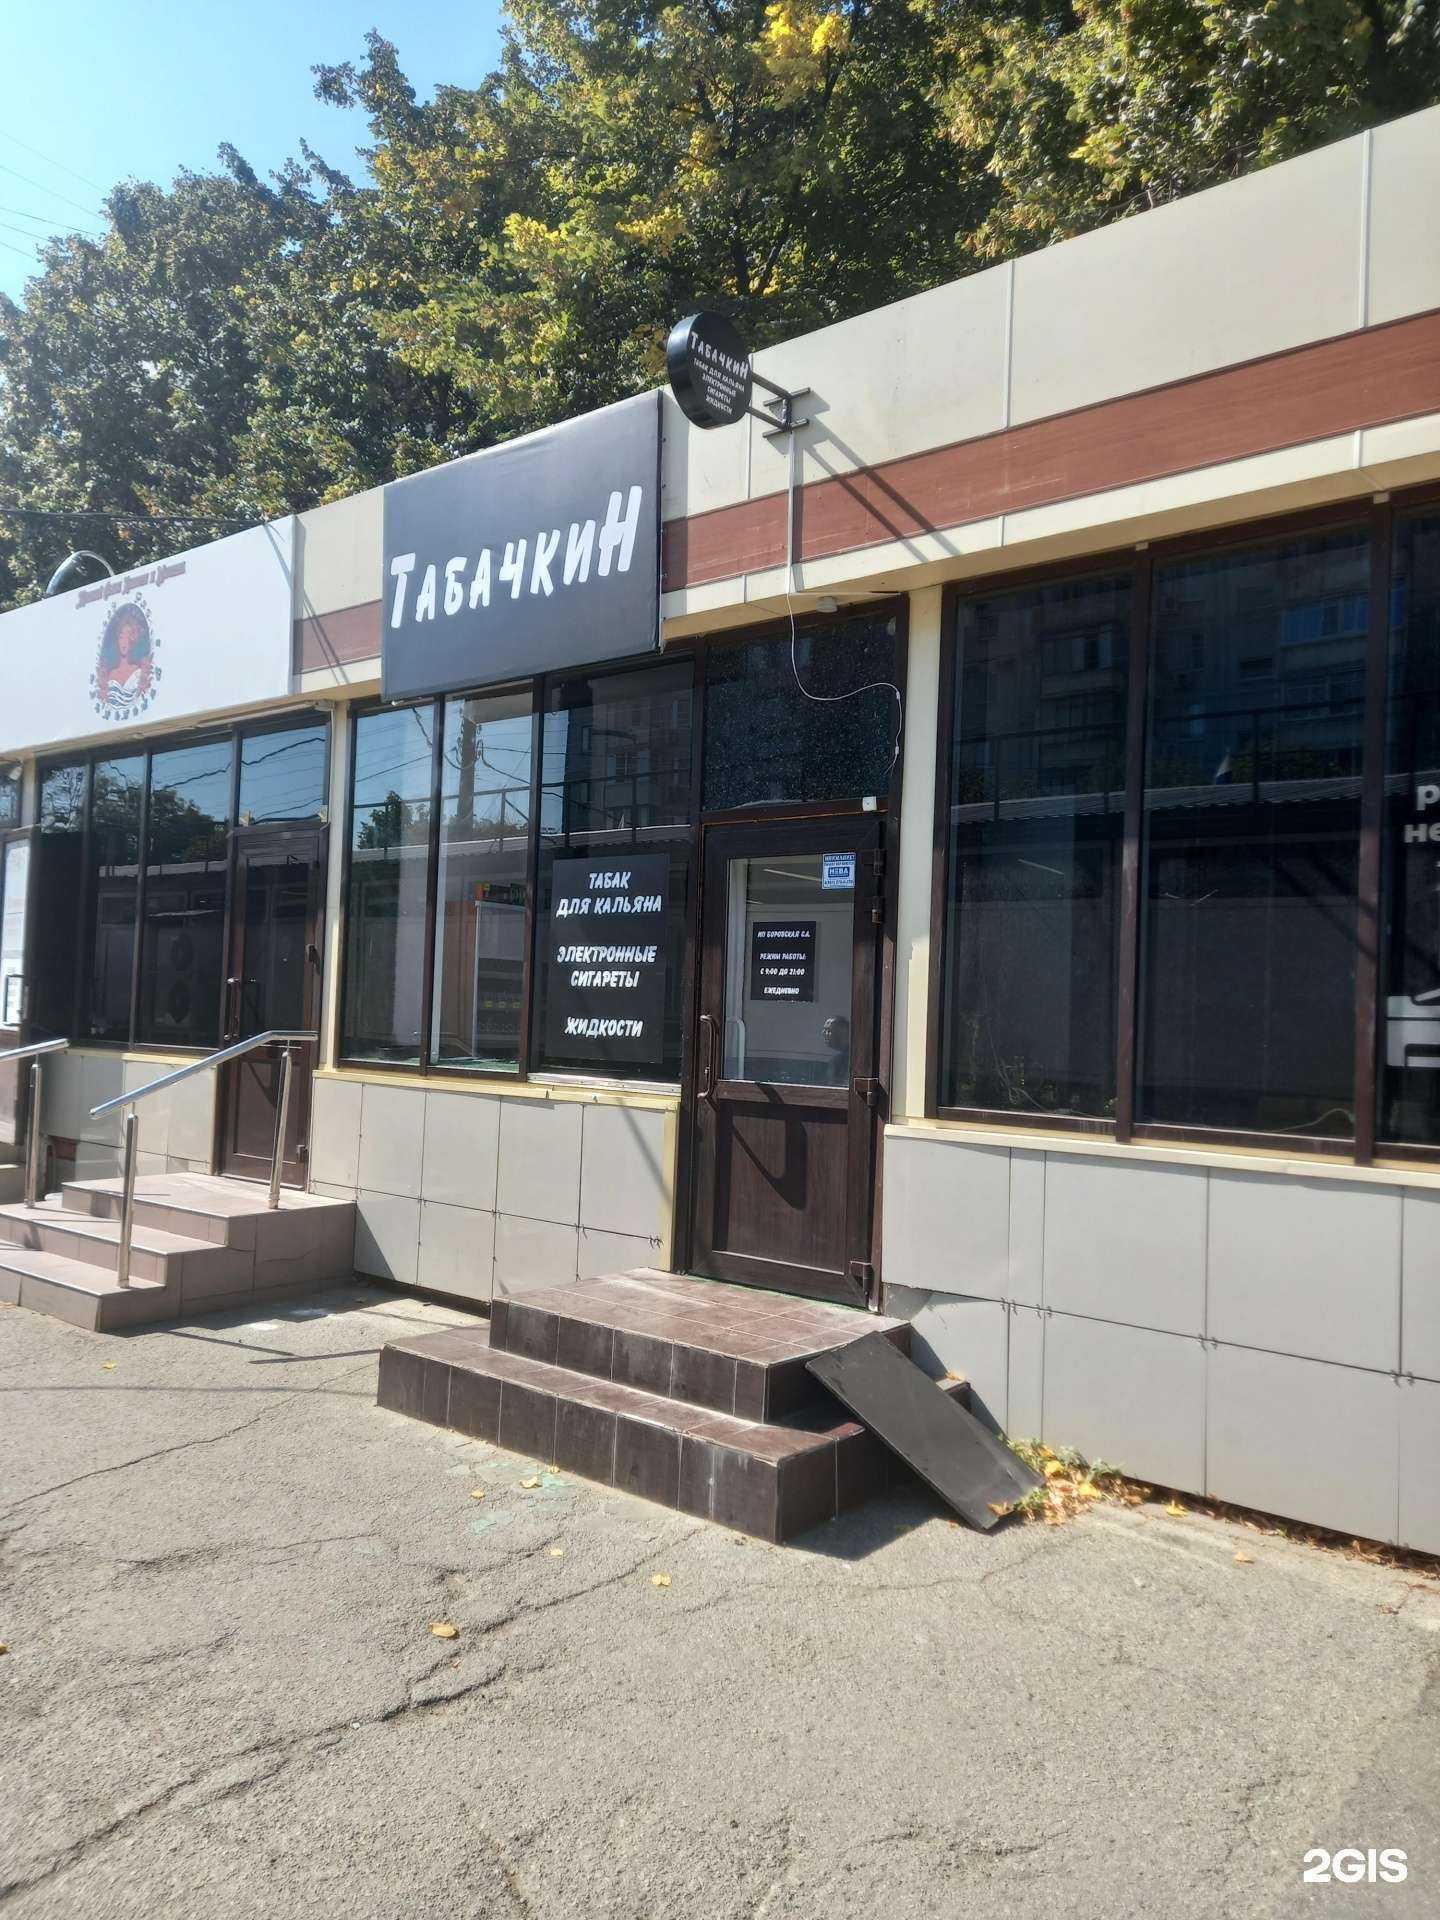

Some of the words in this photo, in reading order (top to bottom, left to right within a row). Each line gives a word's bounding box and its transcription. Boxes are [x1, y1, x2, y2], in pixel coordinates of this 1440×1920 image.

[691, 331, 749, 379] ТАБАЧКИН
[709, 367, 722, 379] ДЛЯ
[390, 485, 643, 629] ТАБАЧКИН
[589, 871, 632, 889] ТАБАК
[556, 897, 591, 918] ДЛЯ
[594, 895, 662, 915] КАЛЬЯНА
[557, 946, 658, 964] ЭЛЕКТРОННЫЕ
[571, 970, 640, 988] СИГАРЕТЫ
[760, 967, 765, 975] С
[779, 968, 788, 976] ДО
[763, 987, 800, 995] ЕЖЕДНЕВНО
[564, 1017, 643, 1038] ЖИДКОСТИ
